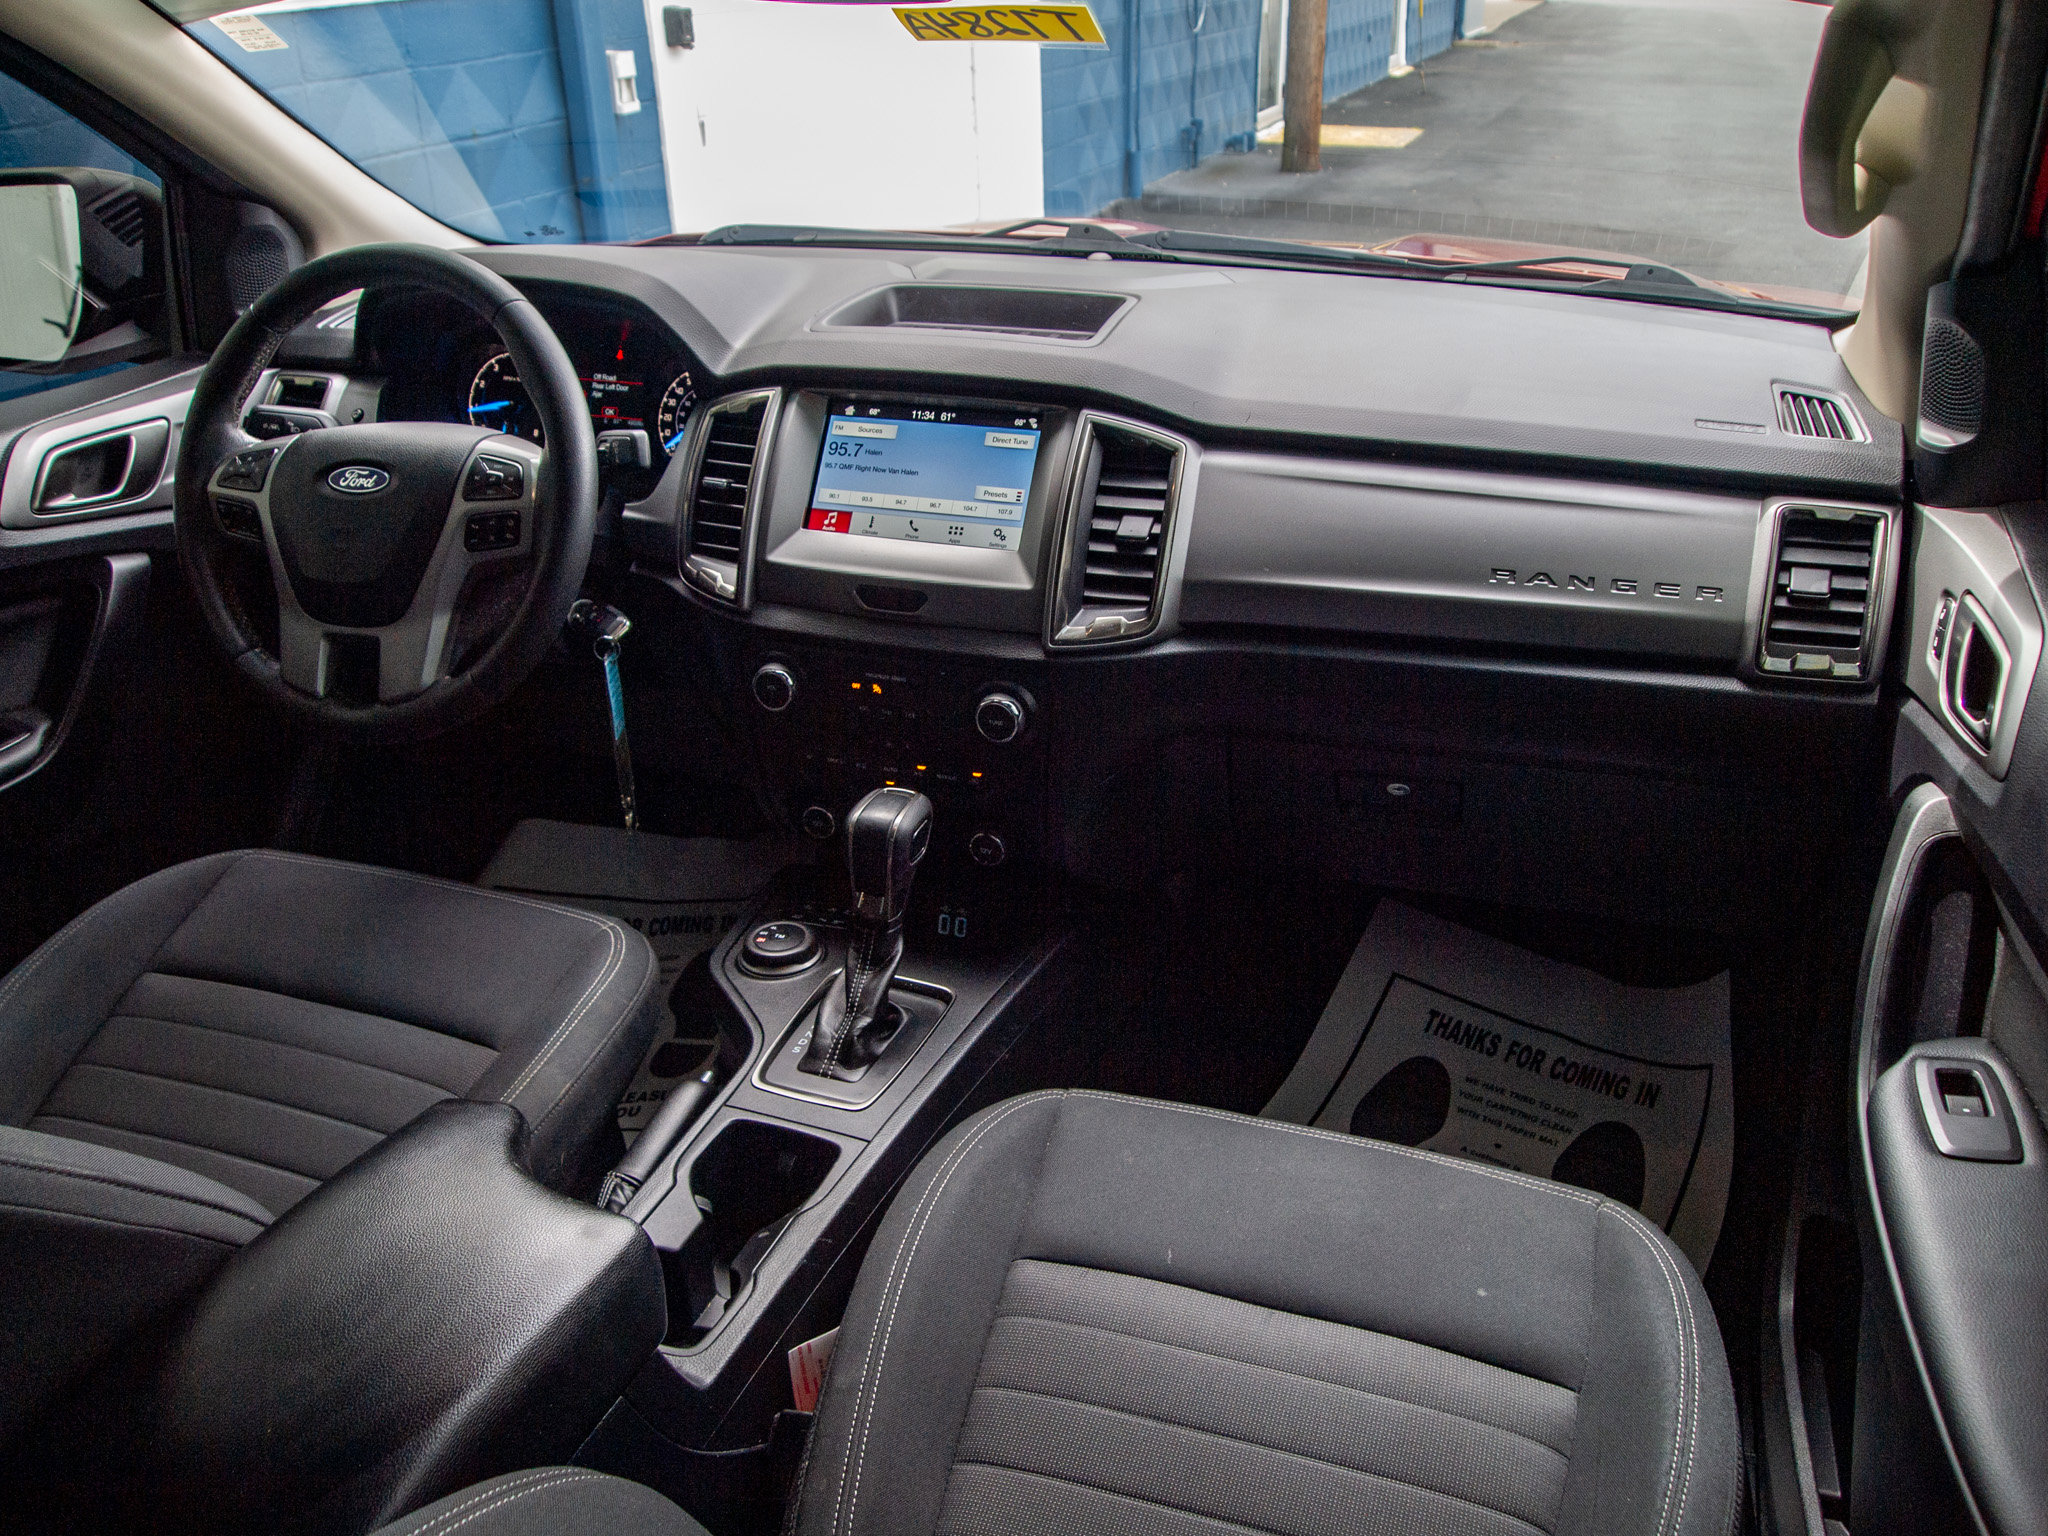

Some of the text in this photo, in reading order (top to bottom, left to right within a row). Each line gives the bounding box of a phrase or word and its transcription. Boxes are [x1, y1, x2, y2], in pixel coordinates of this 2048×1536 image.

[912, 410, 956, 421] 11:34 61°
[858, 426, 883, 434] Sources
[828, 441, 883, 457] 95.7 Halen
[992, 436, 1028, 446] Direct Tune
[340, 469, 378, 488] Ford
[855, 464, 871, 473] Right
[872, 465, 887, 473] Now
[888, 467, 900, 475] Van
[900, 468, 919, 476] Halen
[983, 489, 1008, 498] Presets
[1489, 568, 1724, 603] RANGER
[648, 915, 715, 937] COMING
[1423, 1009, 1661, 1109] THANKS FOR COMING IN
[1481, 1080, 1507, 1098] HAVE
[1459, 1089, 1573, 1135] YOUR CARPETING CLEAN
[1456, 1105, 1559, 1148] WITH THIS PAPER MAT
